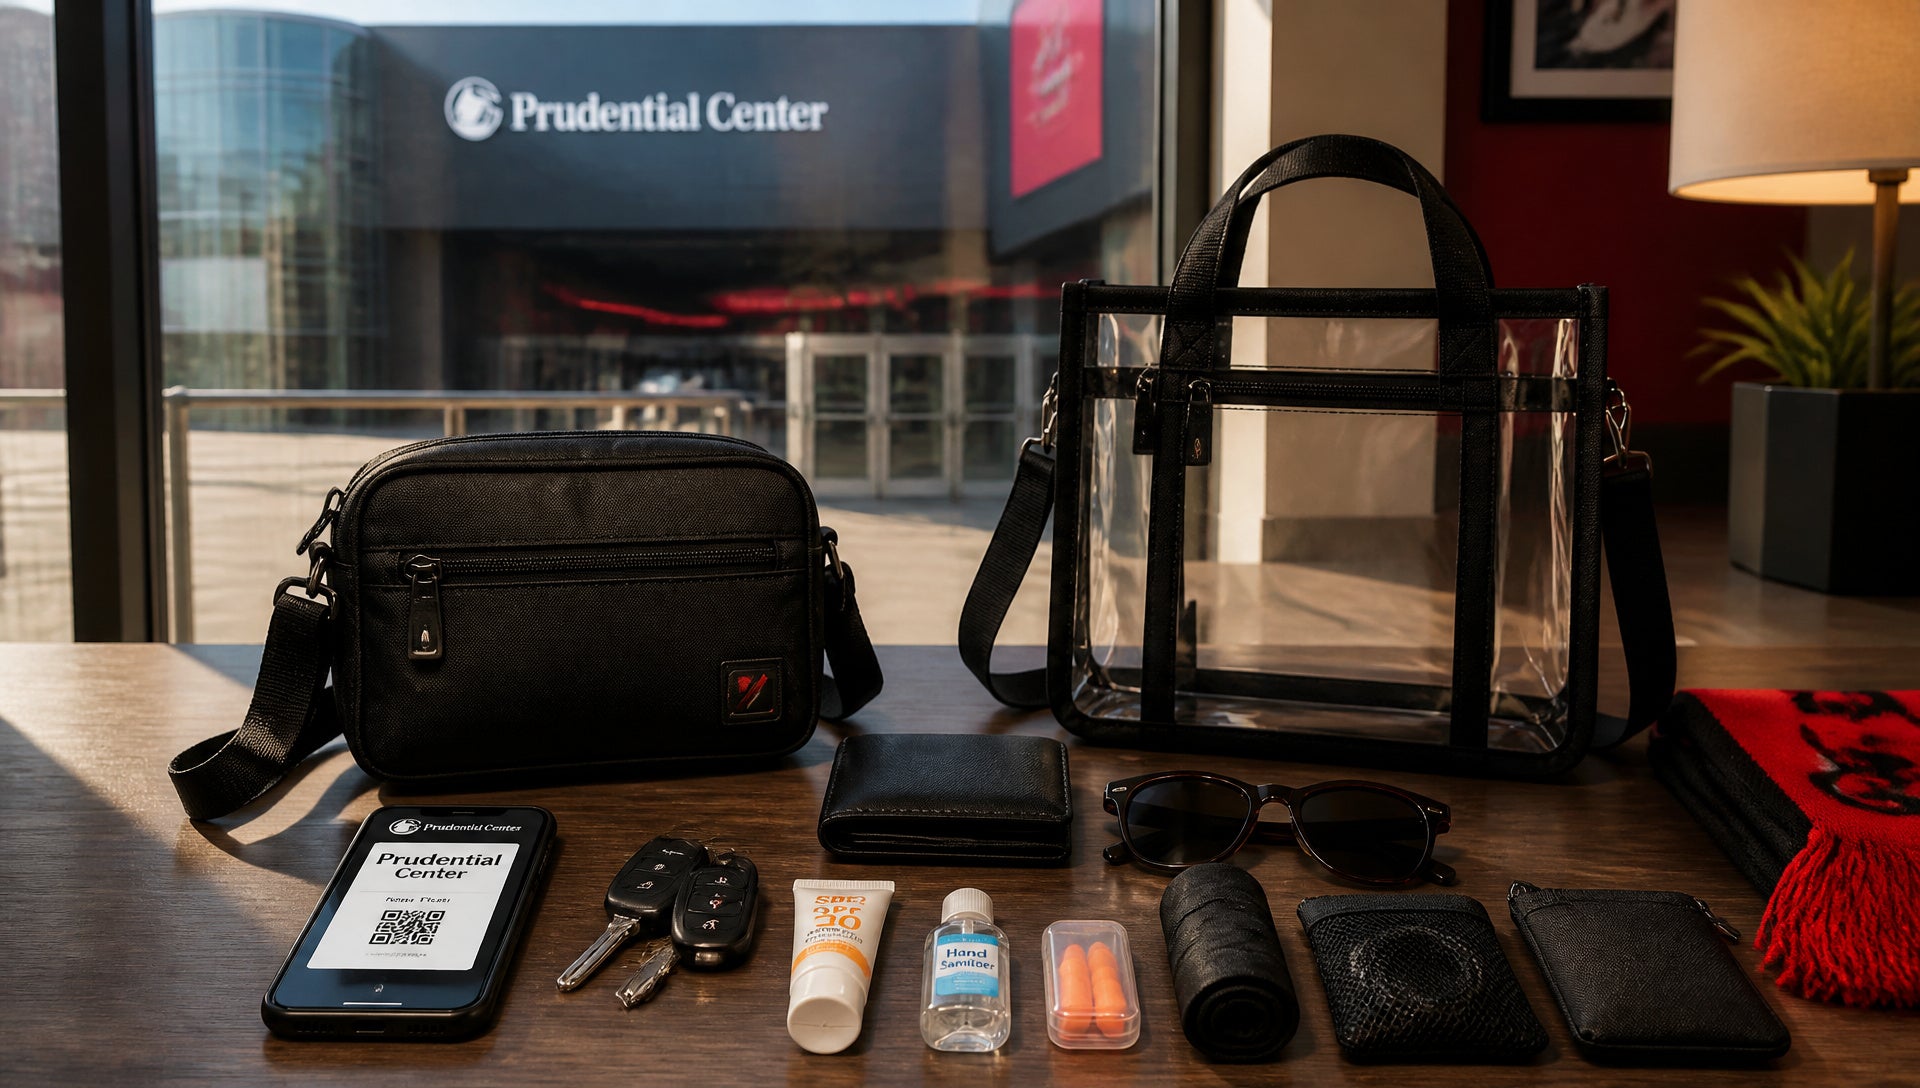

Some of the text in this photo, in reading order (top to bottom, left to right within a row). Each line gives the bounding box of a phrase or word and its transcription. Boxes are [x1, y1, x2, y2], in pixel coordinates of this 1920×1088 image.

[509, 91, 829, 132] Prudential Center
[376, 853, 502, 866] Prudential
[394, 867, 468, 879] Center
[946, 948, 987, 958] Hand
